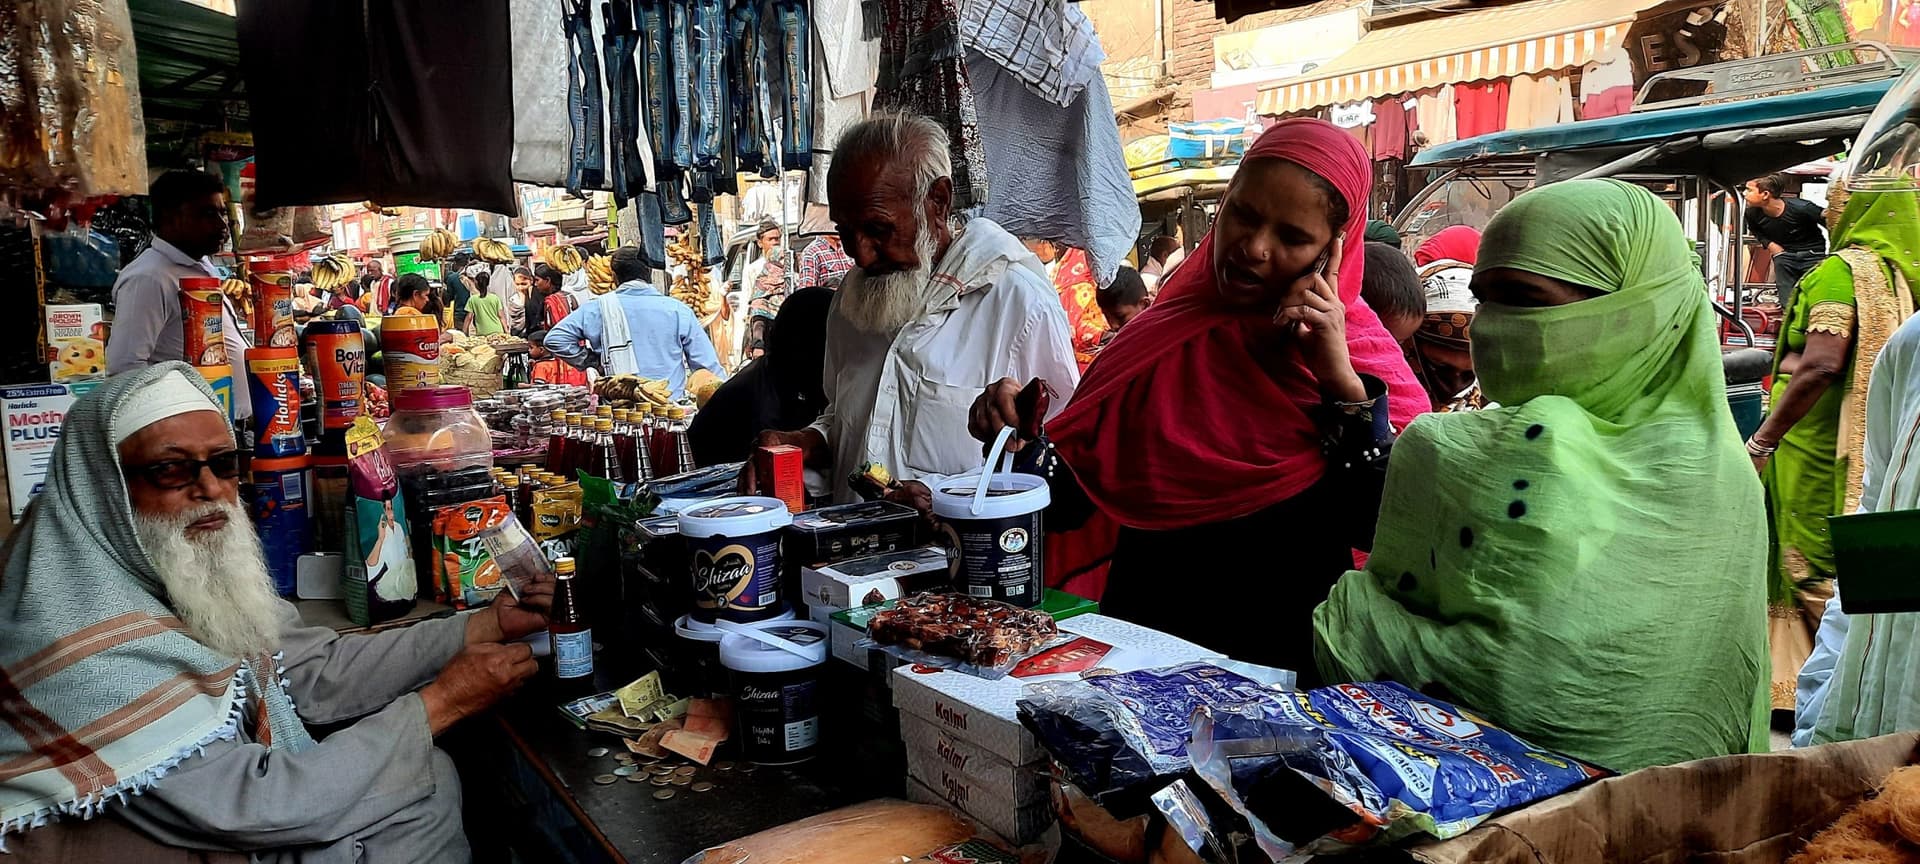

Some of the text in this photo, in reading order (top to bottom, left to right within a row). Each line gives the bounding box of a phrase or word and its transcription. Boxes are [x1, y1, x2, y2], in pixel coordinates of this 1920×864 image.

[419, 342, 438, 351] Comp
[8, 401, 37, 409] Horlicks
[272, 373, 290, 425] Horlicks
[9, 411, 64, 427] Moth
[11, 426, 62, 441] PLUS
[697, 563, 751, 592] Shizaa
[741, 685, 780, 700] Shizaa
[935, 701, 968, 730] Kalmi
[937, 739, 969, 772] Kalmi
[942, 770, 969, 801] Kalmi
[1388, 750, 1431, 794] material
